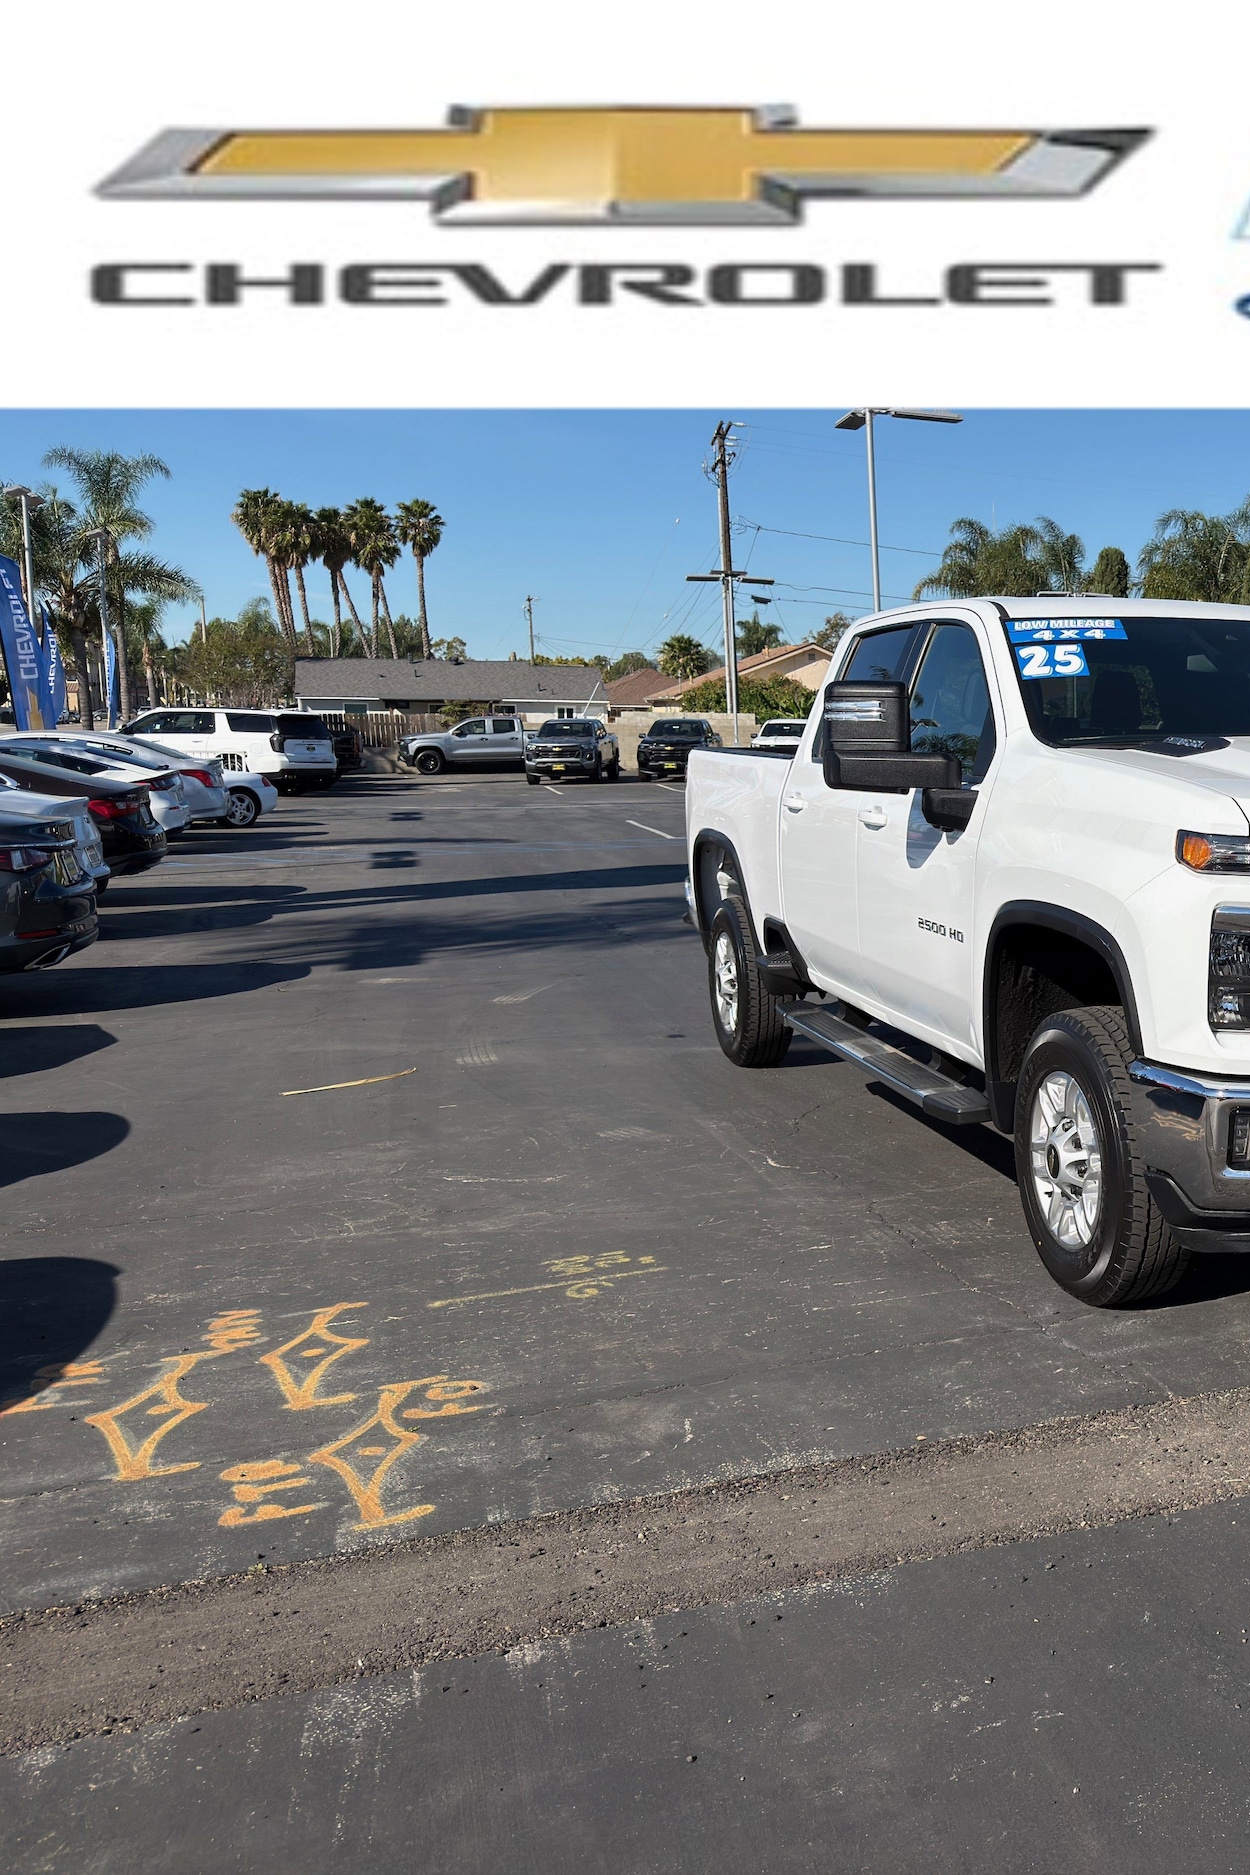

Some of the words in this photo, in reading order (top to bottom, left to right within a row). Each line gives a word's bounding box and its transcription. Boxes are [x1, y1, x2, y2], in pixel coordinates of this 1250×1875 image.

[1014, 620, 1049, 631] LOW
[1049, 618, 1116, 629] MILEAGE
[1018, 645, 1085, 678] 25
[917, 916, 947, 937] 2500
[949, 927, 965, 944] HD
